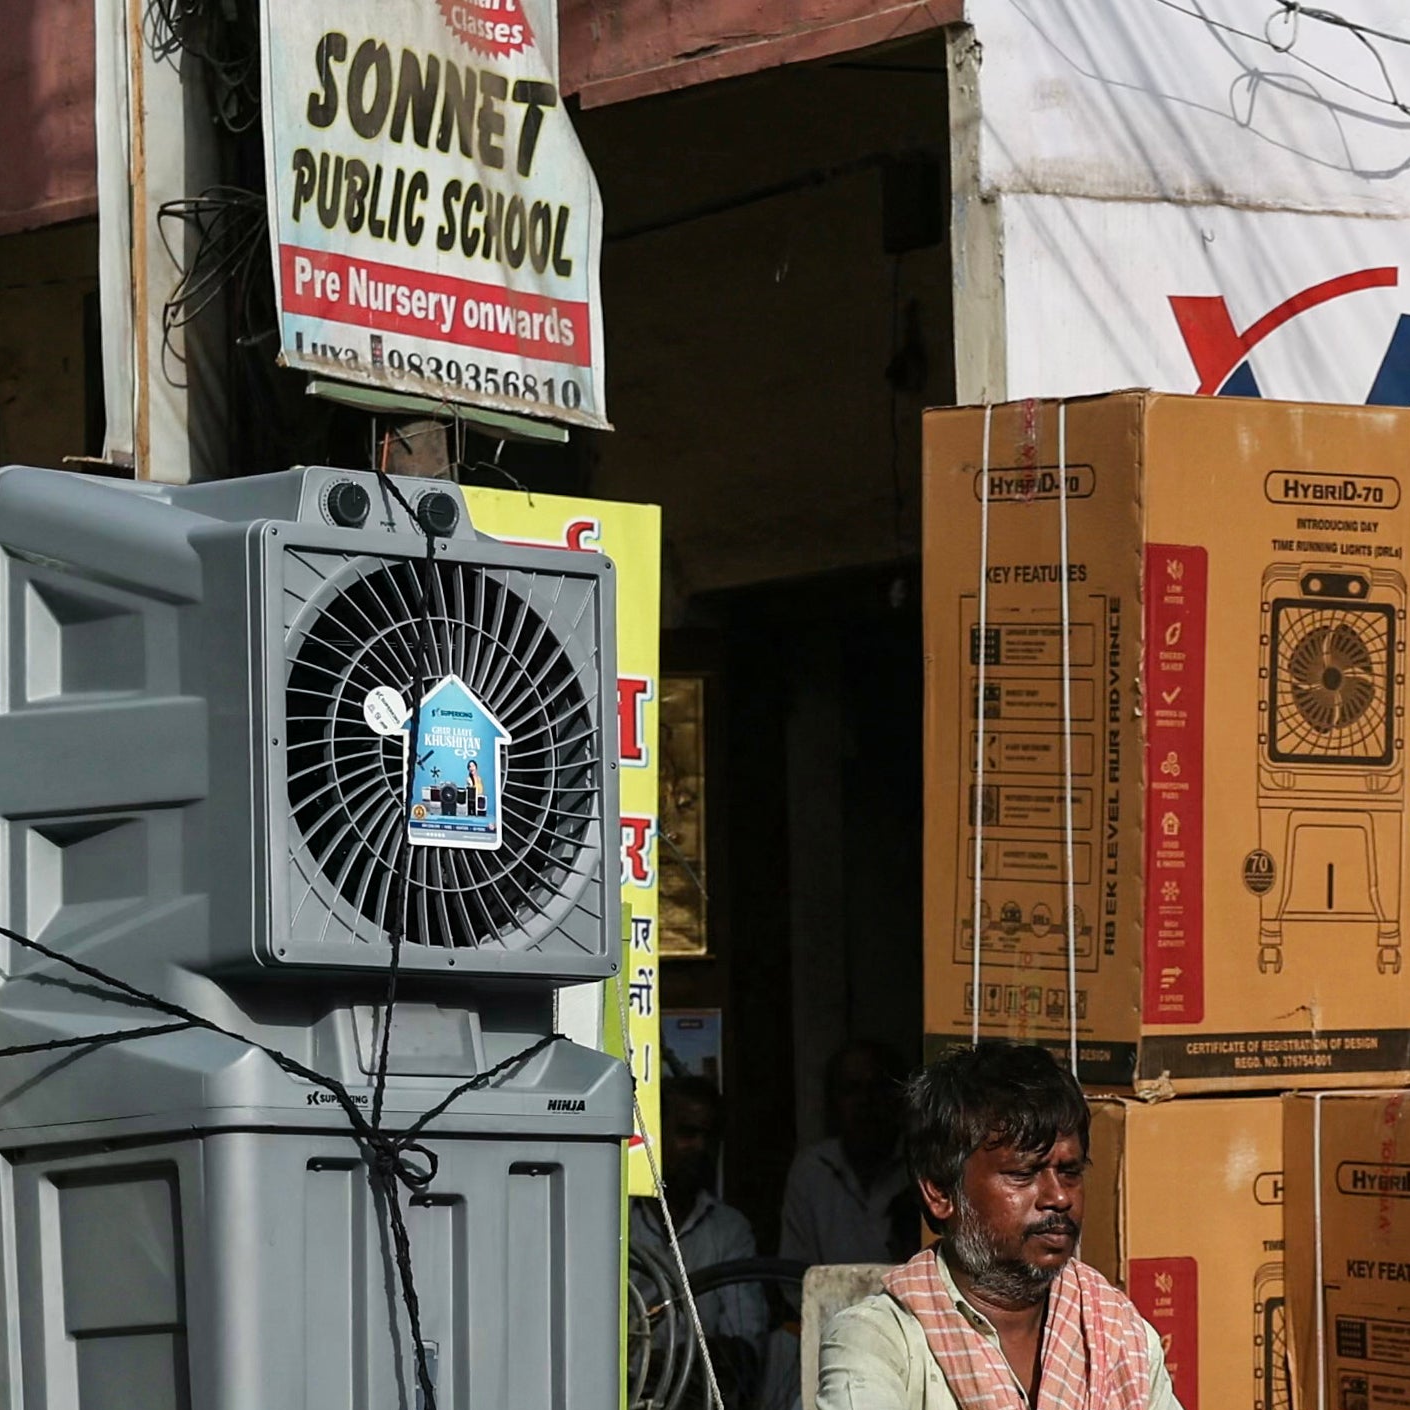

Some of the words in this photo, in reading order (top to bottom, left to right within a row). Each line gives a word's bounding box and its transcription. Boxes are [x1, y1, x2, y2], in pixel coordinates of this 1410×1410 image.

[464, 0, 517, 12] art
[449, 6, 524, 45] Classes
[306, 31, 558, 178] SONNET
[291, 147, 430, 248] PUBLIC
[435, 177, 574, 279] SCHOOL
[294, 255, 341, 303] Pre
[347, 265, 458, 335] Nursery
[462, 293, 575, 347] onwards
[1283, 478, 1384, 503] HYBRID-70
[1297, 518, 1359, 531] INTRODUCING
[1360, 521, 1379, 533] DAY
[1271, 539, 1294, 551] TIME
[1296, 540, 1338, 553] RUNNING
[1340, 543, 1372, 557] LIGHTS
[986, 566, 1010, 584] KEY
[1014, 564, 1087, 583] FEATUES
[1108, 597, 1121, 722] ADVANCE
[424, 733, 481, 750] KHUSHIYAN
[1106, 789, 1120, 875] LEVEL
[1251, 855, 1268, 873] 70
[1186, 1041, 1246, 1055] CERTIFICATE
[1248, 1040, 1260, 1053] OF
[1261, 1038, 1328, 1052] REGISTRATION
[1329, 1037, 1341, 1050] OF
[1344, 1036, 1378, 1050] DESIGN
[1234, 1057, 1262, 1069] REGD.
[1264, 1056, 1280, 1067] NO.
[547, 1099, 586, 1112] NINJA
[1347, 1259, 1375, 1279] KEY
